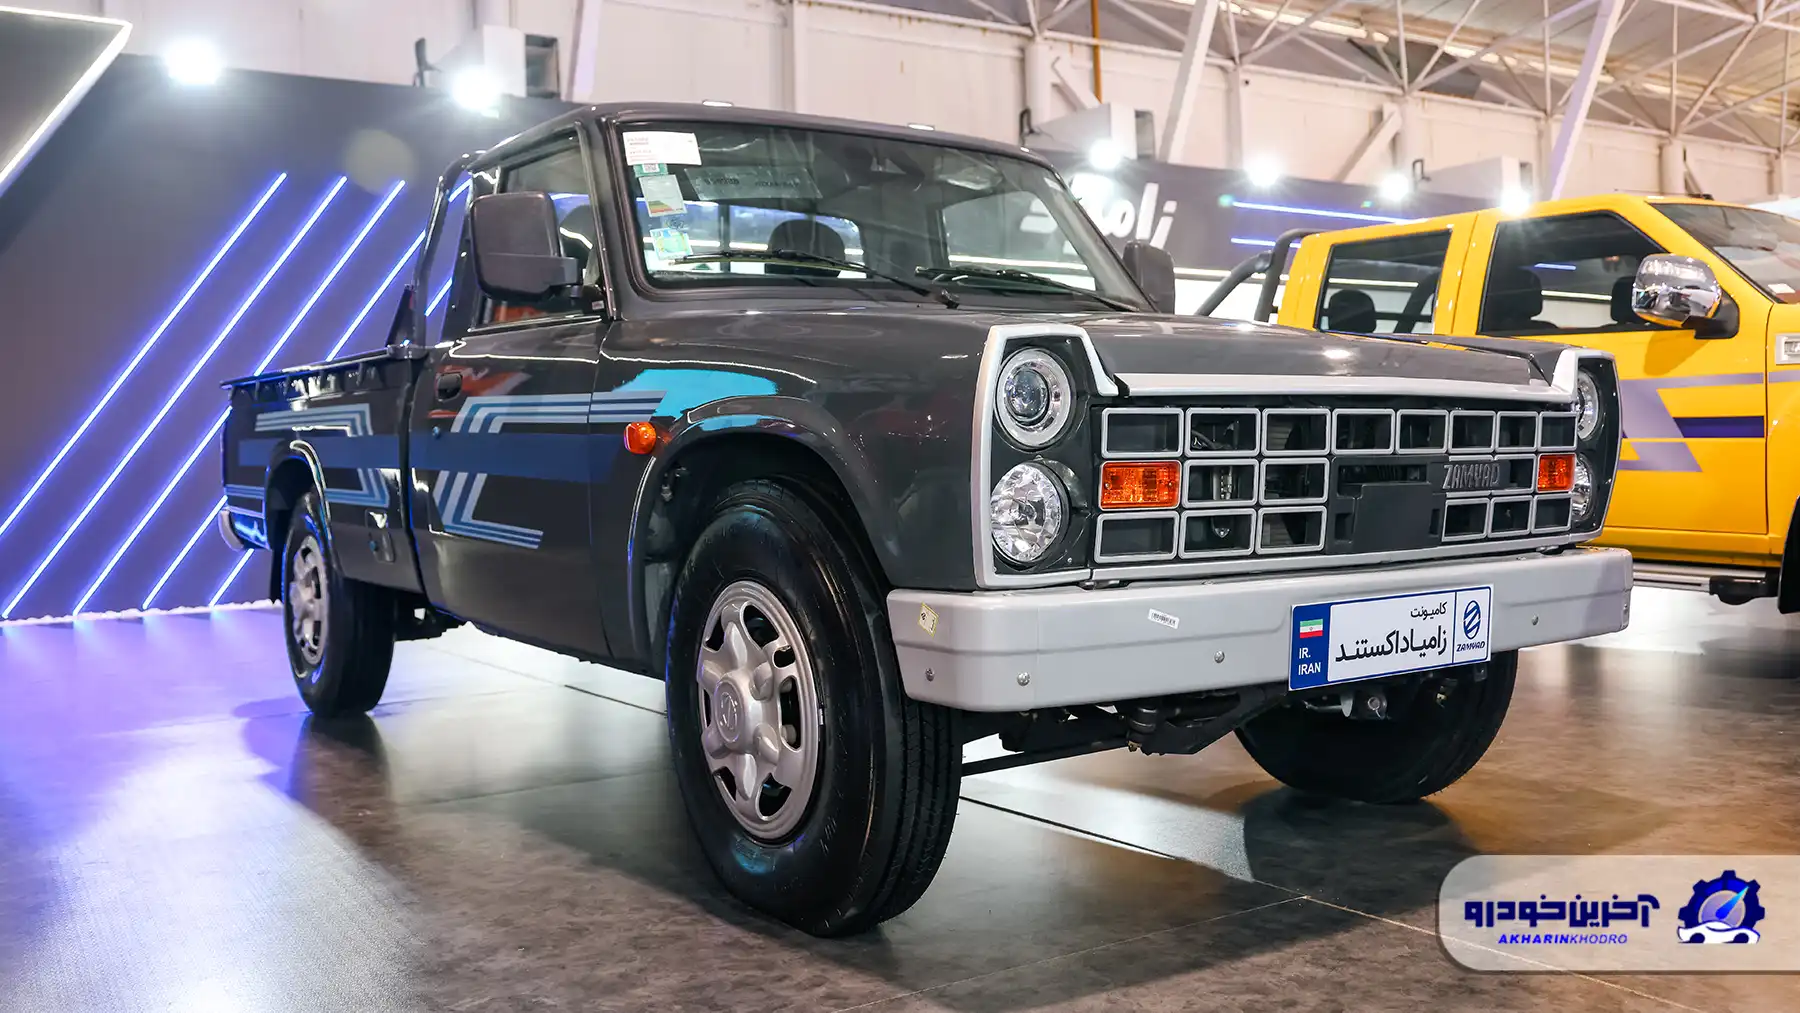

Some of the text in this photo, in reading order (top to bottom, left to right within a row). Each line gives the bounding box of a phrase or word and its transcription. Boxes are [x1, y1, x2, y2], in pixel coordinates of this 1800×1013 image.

[1442, 462, 1500, 491] ZAMYAD
[1410, 601, 1448, 621] کامیونت
[1298, 647, 1311, 659] IR.
[1456, 640, 1486, 653] ZAMYAD
[1298, 661, 1322, 676] IRAN
